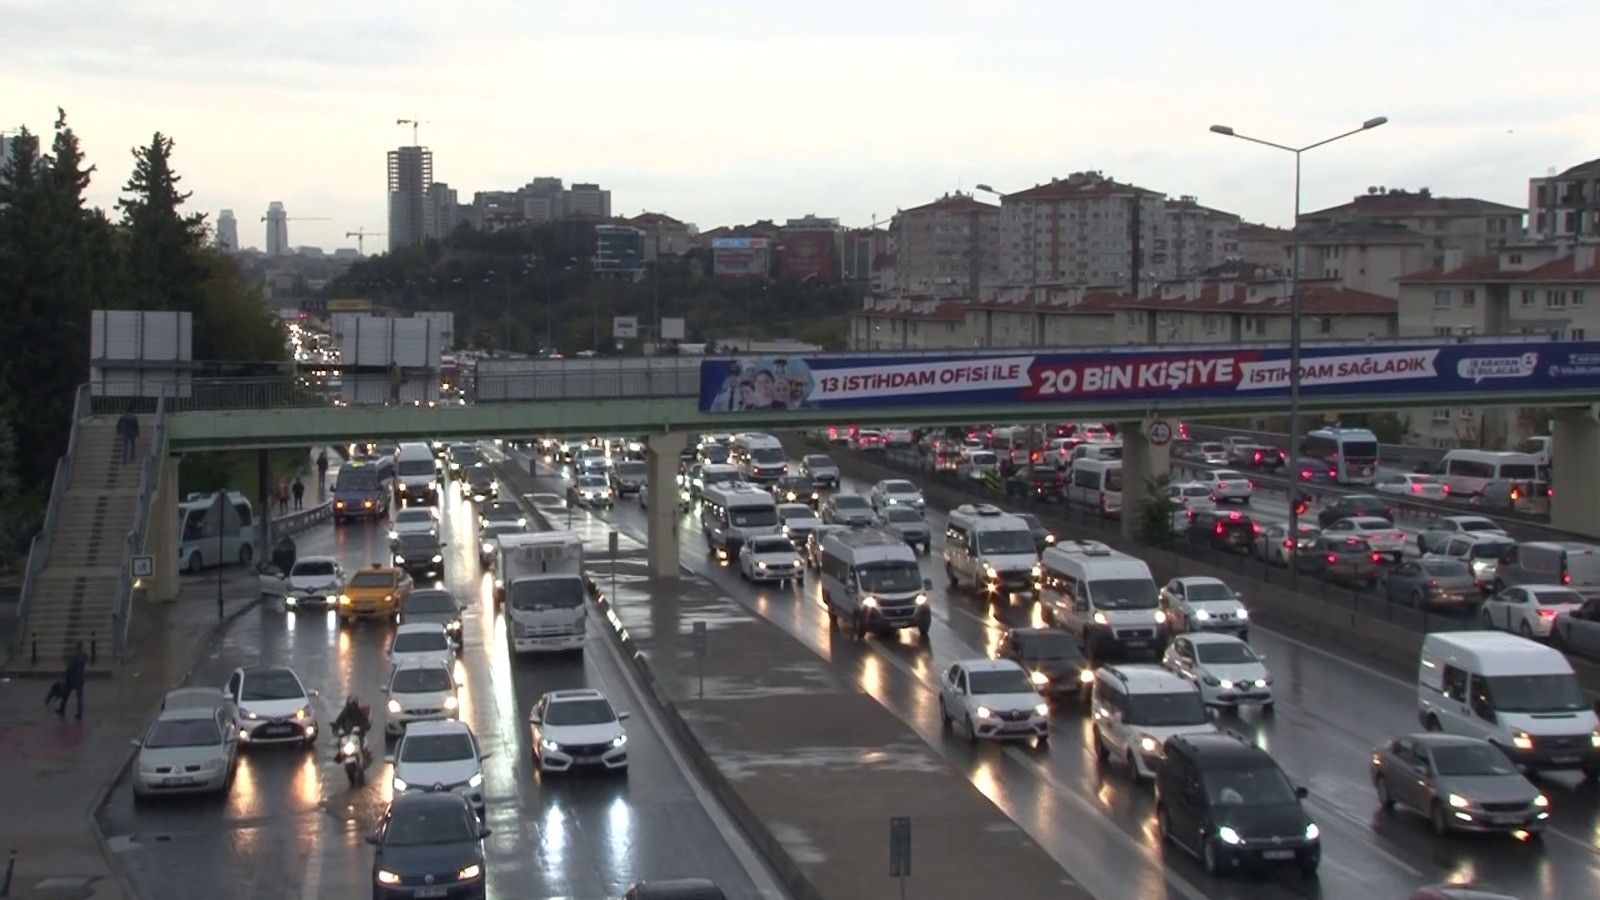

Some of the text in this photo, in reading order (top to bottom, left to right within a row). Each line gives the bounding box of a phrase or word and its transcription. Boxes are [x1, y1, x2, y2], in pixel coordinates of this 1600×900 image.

[820, 363, 1020, 393] 13 İSTİHDAM OFİSİ İLE
[1038, 357, 1235, 394] 20 BİN KİŞİYE
[1337, 355, 1426, 377] SAĞLADIK
